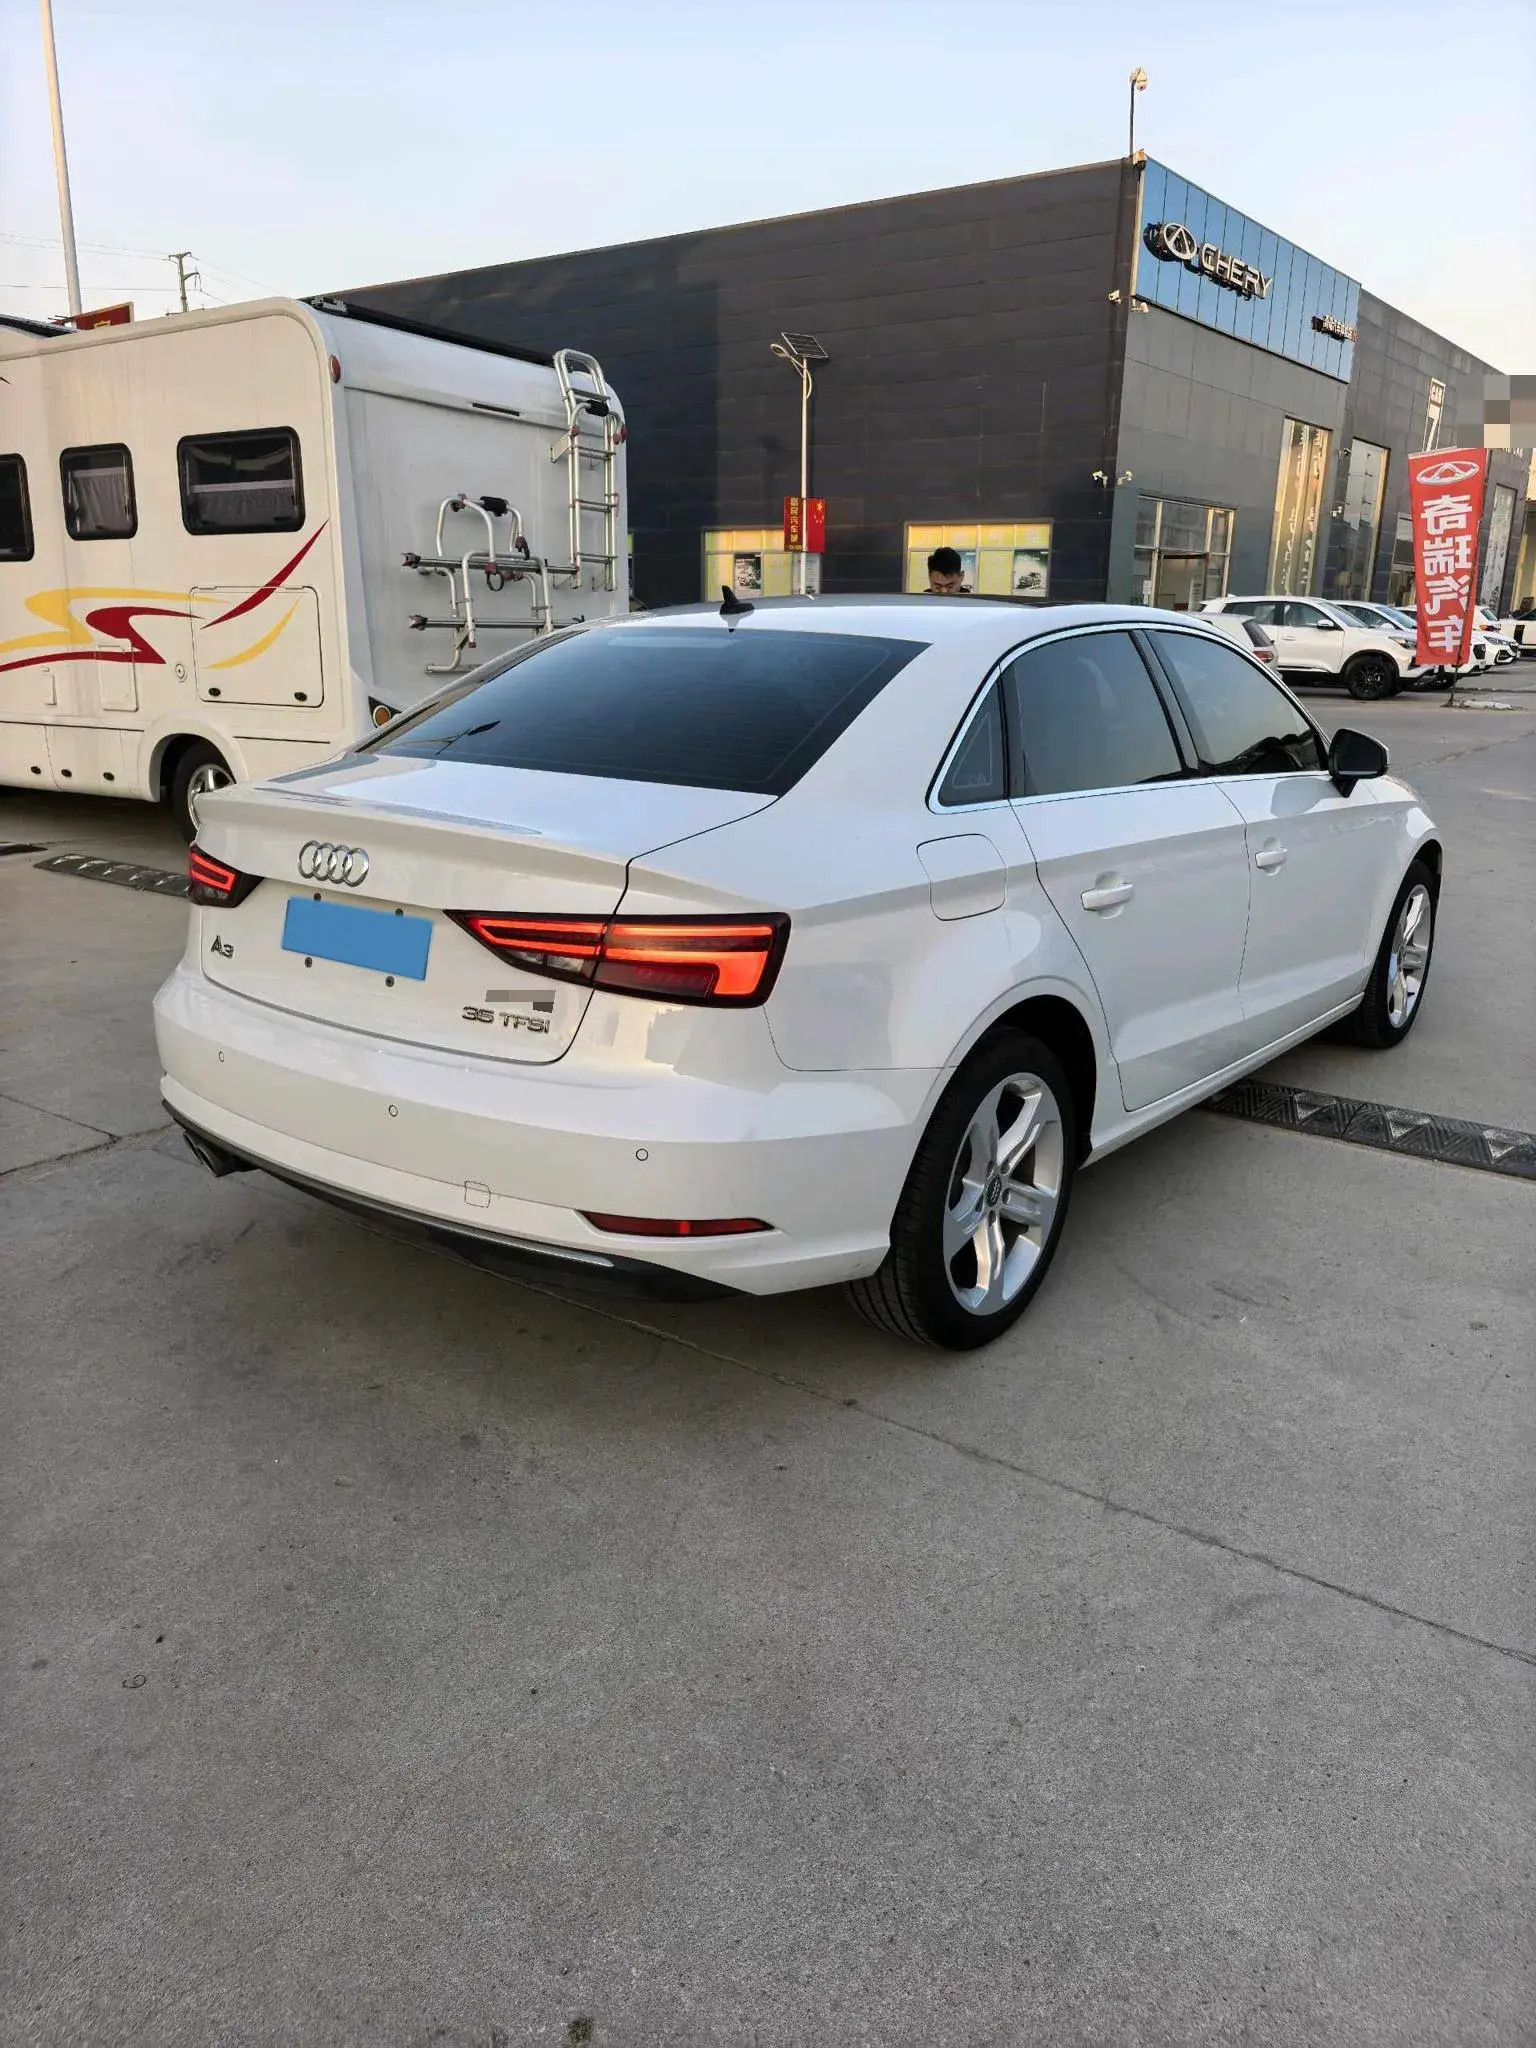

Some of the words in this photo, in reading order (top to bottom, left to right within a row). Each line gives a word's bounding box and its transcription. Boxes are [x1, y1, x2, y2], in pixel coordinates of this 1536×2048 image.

[1201, 242, 1274, 299] CHERY
[210, 934, 236, 960] A3
[461, 1005, 495, 1025] 35
[498, 1009, 552, 1035] TFSI
